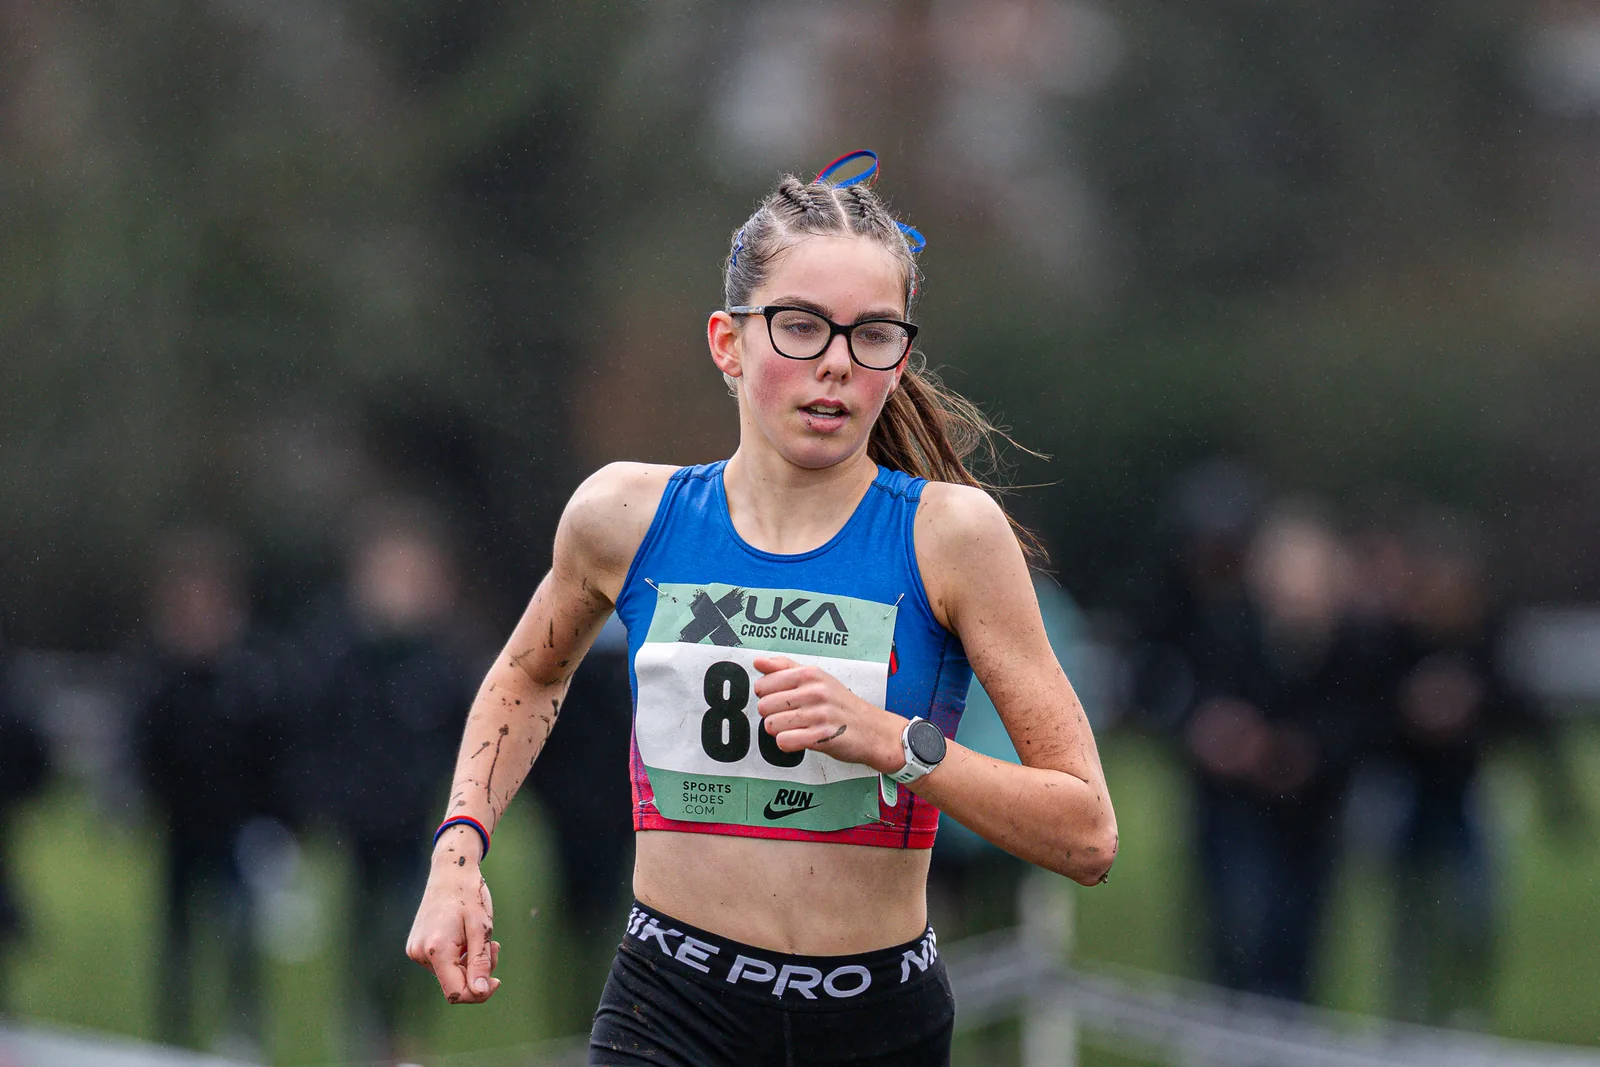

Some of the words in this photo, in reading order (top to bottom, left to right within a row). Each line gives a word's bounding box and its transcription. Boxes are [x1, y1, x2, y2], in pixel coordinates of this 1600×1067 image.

[745, 595, 849, 632] UKA
[740, 623, 777, 639] CROSS
[780, 627, 849, 646] CHALLENGE
[683, 781, 732, 793] SPORTS
[682, 792, 724, 805] SHOES
[774, 788, 814, 808] RUN
[682, 804, 715, 815] .COM
[725, 954, 872, 1000] PRO
